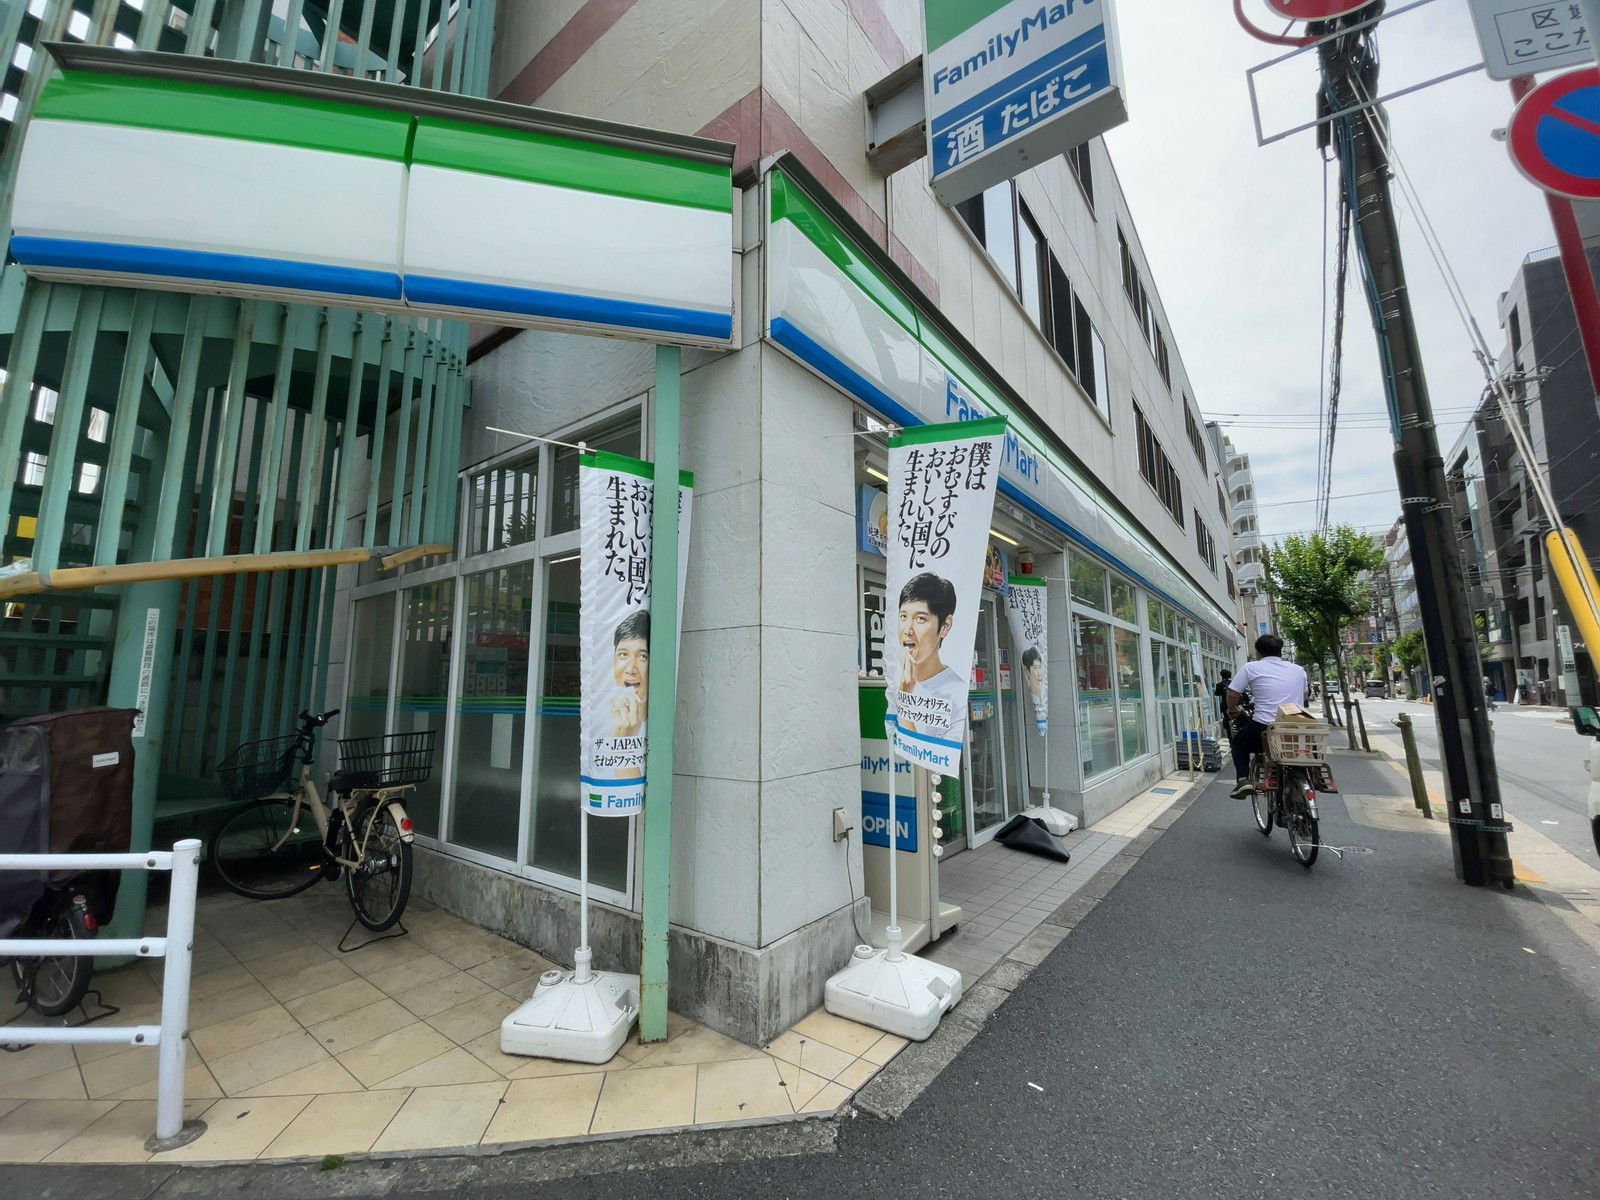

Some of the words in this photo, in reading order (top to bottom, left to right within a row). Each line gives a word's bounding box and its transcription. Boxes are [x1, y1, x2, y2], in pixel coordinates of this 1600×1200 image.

[946, 115, 985, 166] 酒
[1001, 64, 1092, 135] たばこ
[897, 449, 925, 548] 生まれた。
[909, 447, 947, 570] おいしい国に
[929, 445, 968, 559] おむすびの
[964, 441, 993, 491] 僕は
[604, 475, 629, 583] 生まれた。
[626, 479, 648, 606] おいしい国に
[897, 738, 950, 767] FamilyMart
